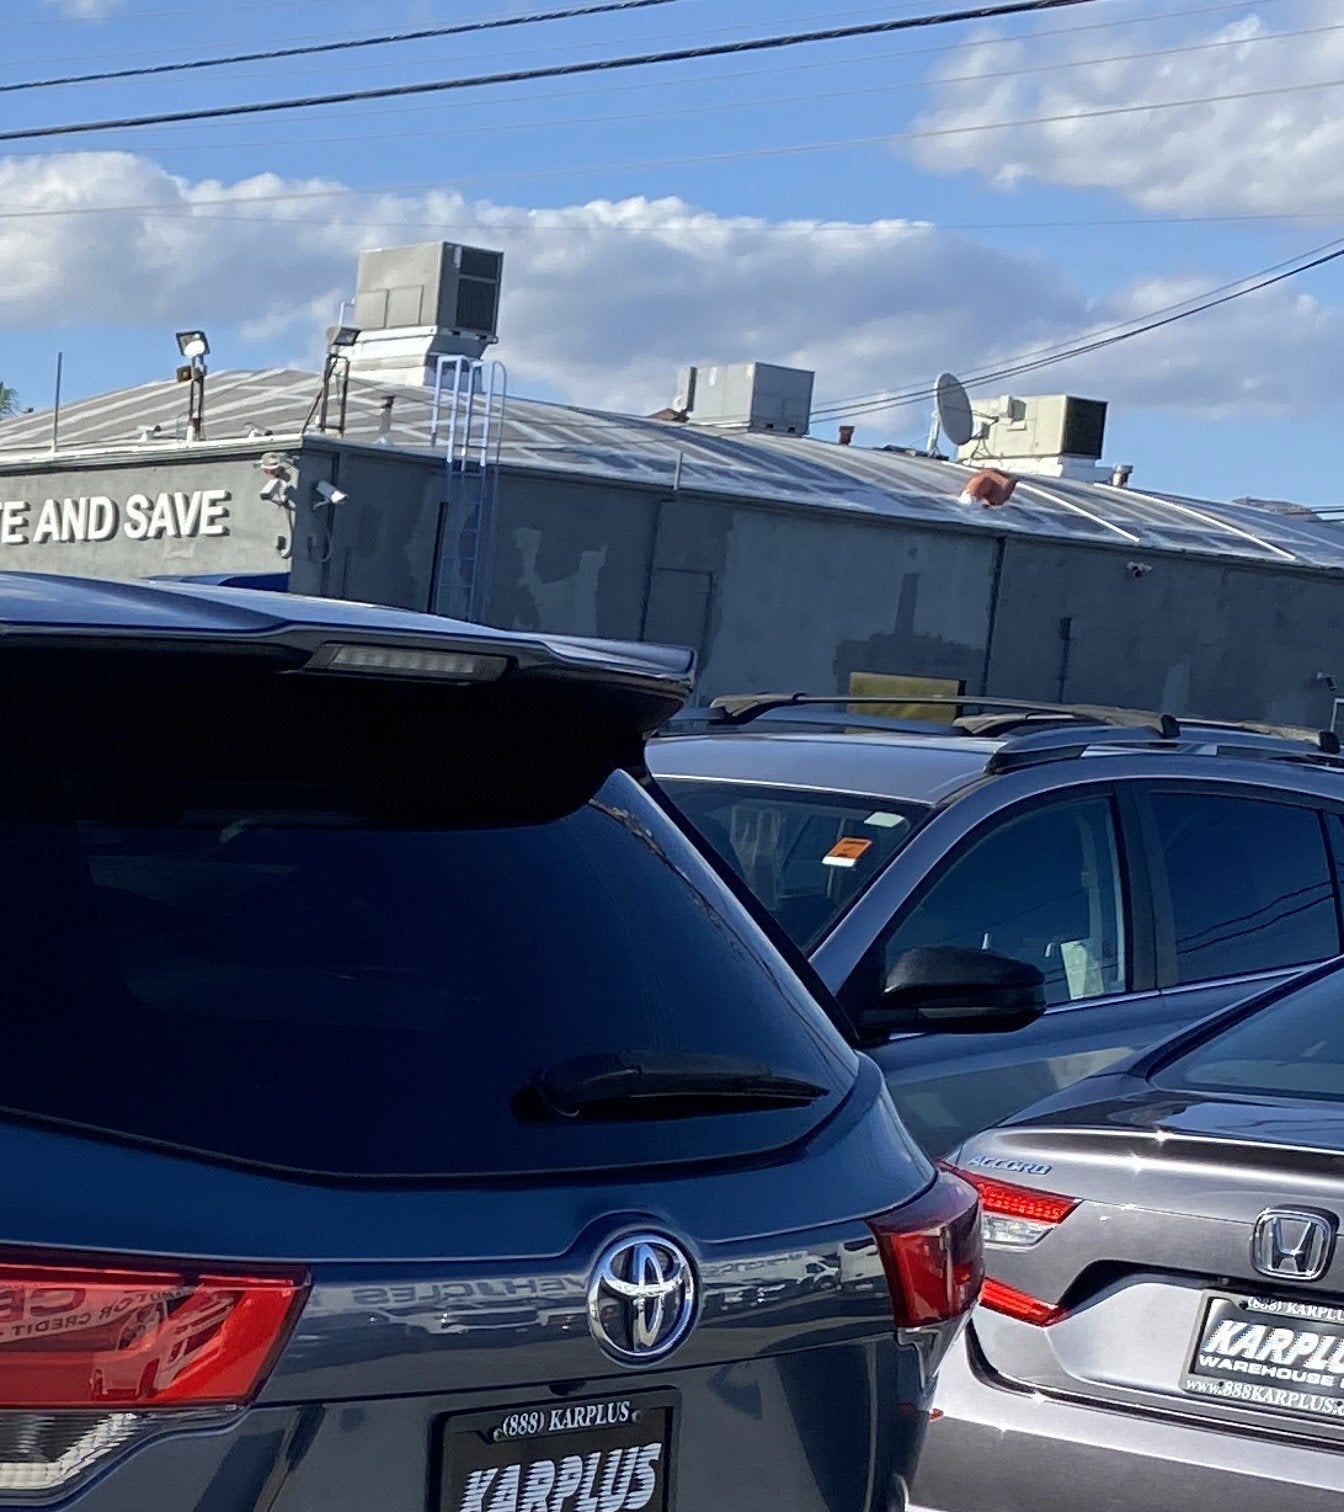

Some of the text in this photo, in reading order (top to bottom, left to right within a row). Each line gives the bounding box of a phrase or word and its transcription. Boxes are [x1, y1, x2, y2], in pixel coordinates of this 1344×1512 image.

[32, 496, 117, 543] AND
[123, 489, 227, 539] SAVE
[968, 1155, 1053, 1175] ACCORD
[1198, 1354, 1336, 1387] WAREHOUSE
[502, 1400, 631, 1436] (888) KARPLUS
